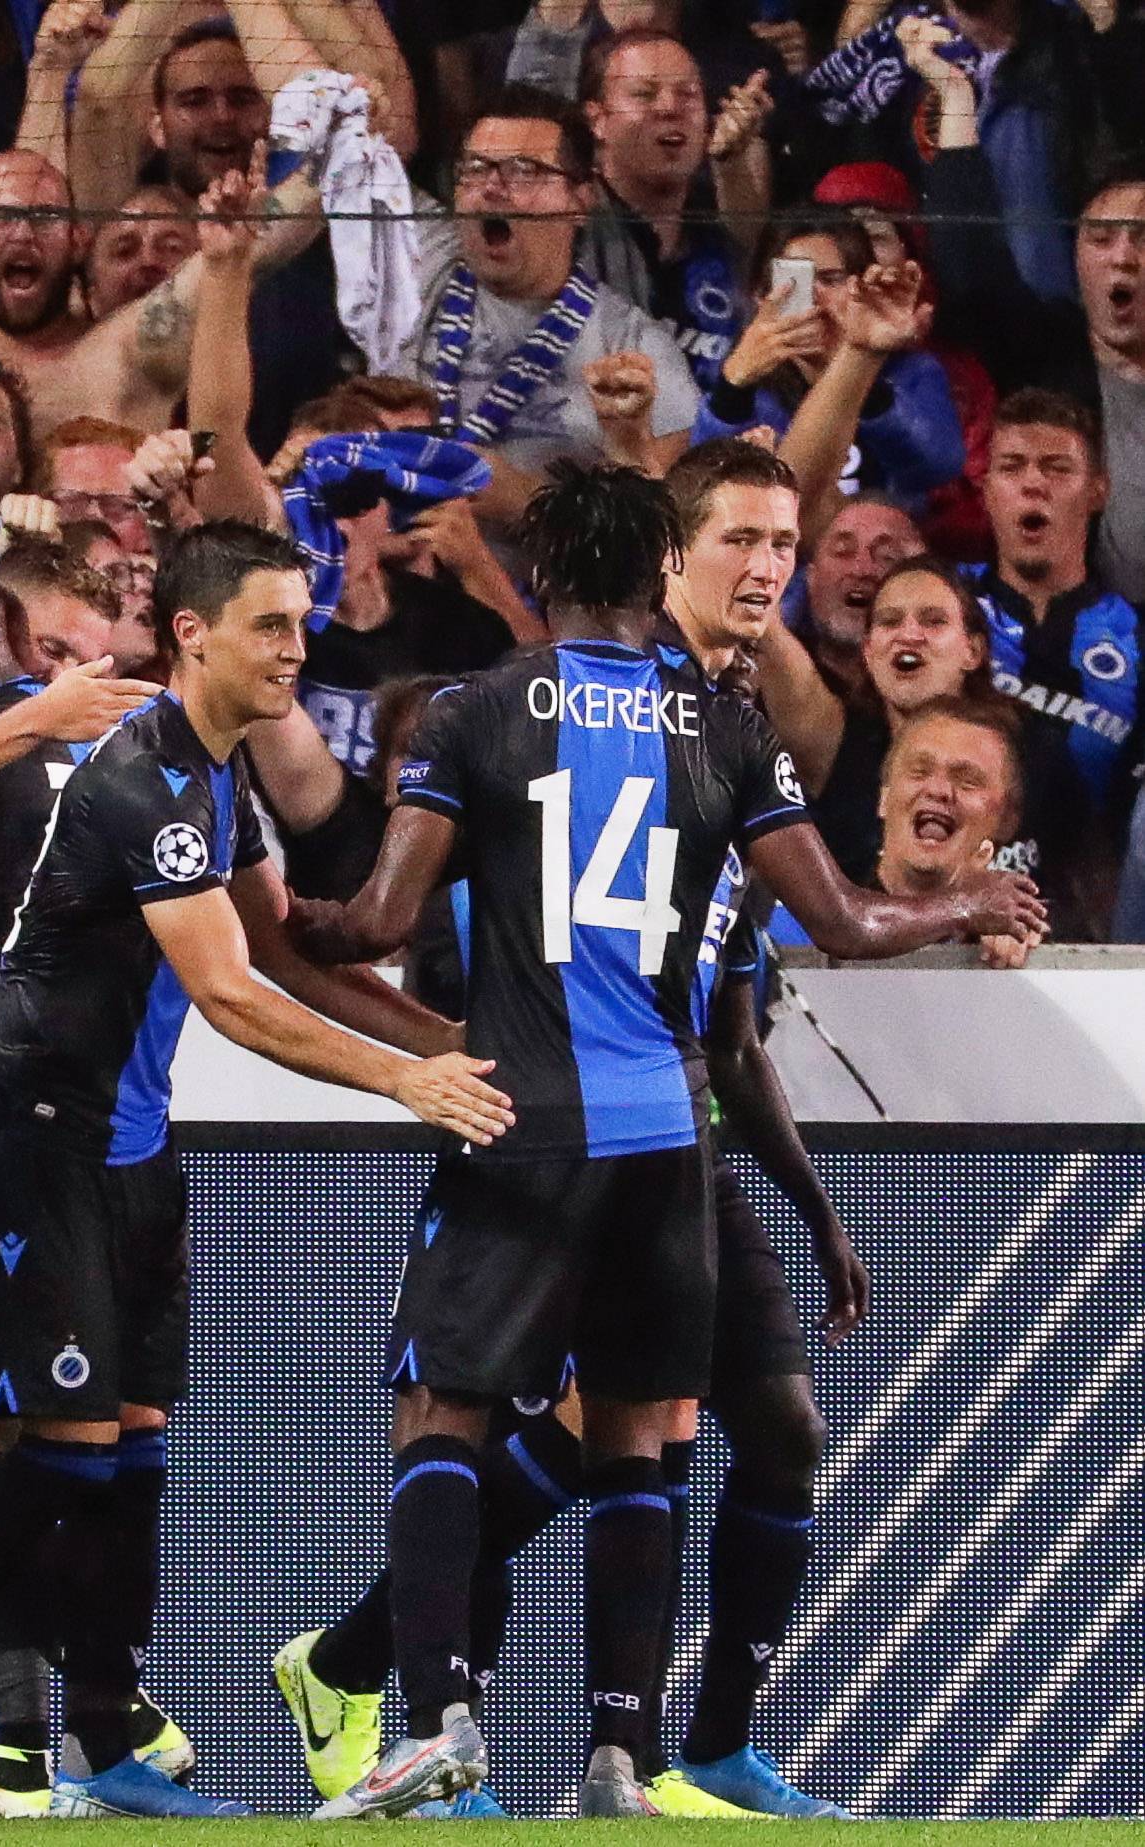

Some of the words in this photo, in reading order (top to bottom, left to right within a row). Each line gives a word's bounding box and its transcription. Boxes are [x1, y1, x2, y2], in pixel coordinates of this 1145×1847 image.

[527, 676, 699, 737] OKEREKE
[528, 768, 682, 976] 14
[592, 1691, 641, 1712] FCB
